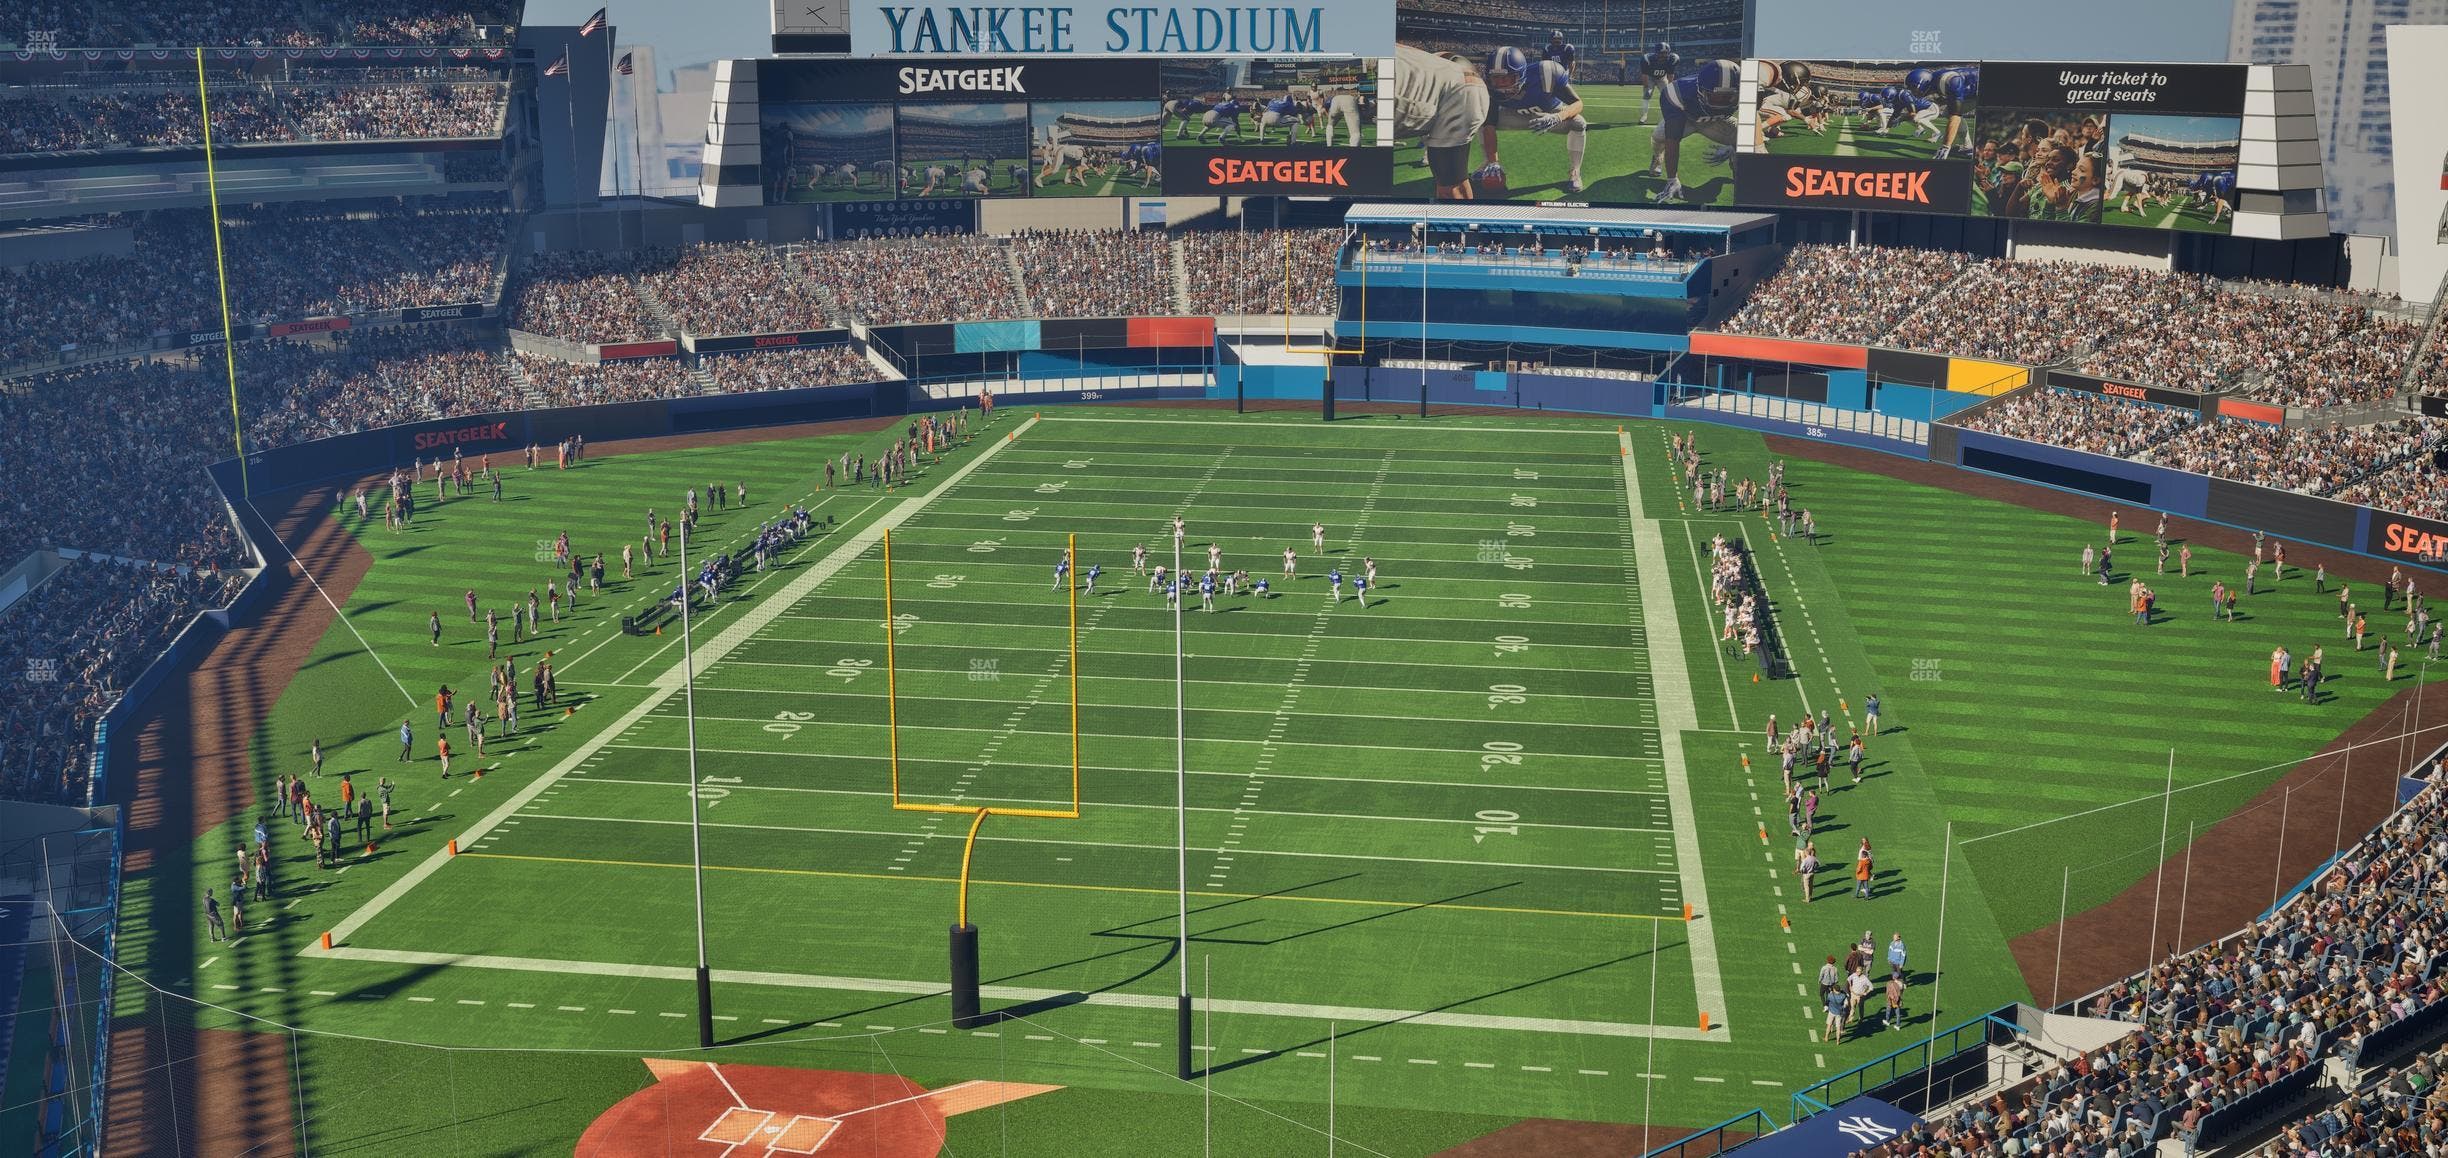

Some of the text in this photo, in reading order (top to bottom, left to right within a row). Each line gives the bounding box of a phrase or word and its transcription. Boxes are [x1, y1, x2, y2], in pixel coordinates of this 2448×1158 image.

[879, 7, 1325, 53] YANKEE STADIUM
[898, 65, 1026, 94] SEATGEEK
[2059, 71, 2168, 86] Your ticket to
[2067, 88, 2157, 104] great seats
[1208, 157, 1349, 186] SEATGEEK
[1786, 166, 1931, 204] SEATGEEK
[420, 308, 463, 320] SEATGEEK
[190, 331, 230, 345] SEATGEE
[755, 335, 799, 347] SEATGEEK
[2103, 382, 2147, 400] SEATGEEK
[414, 422, 507, 450] SEATGEEK
[1507, 524, 1537, 537] 30
[1504, 557, 1534, 570] 40
[1499, 593, 1532, 609] 50
[1494, 635, 1529, 652] 40
[825, 658, 873, 677] 30
[1487, 684, 1527, 704] 30
[762, 710, 815, 732] 20
[1481, 741, 1523, 765] 20
[687, 775, 743, 799] 10
[1474, 809, 1520, 836] 10
